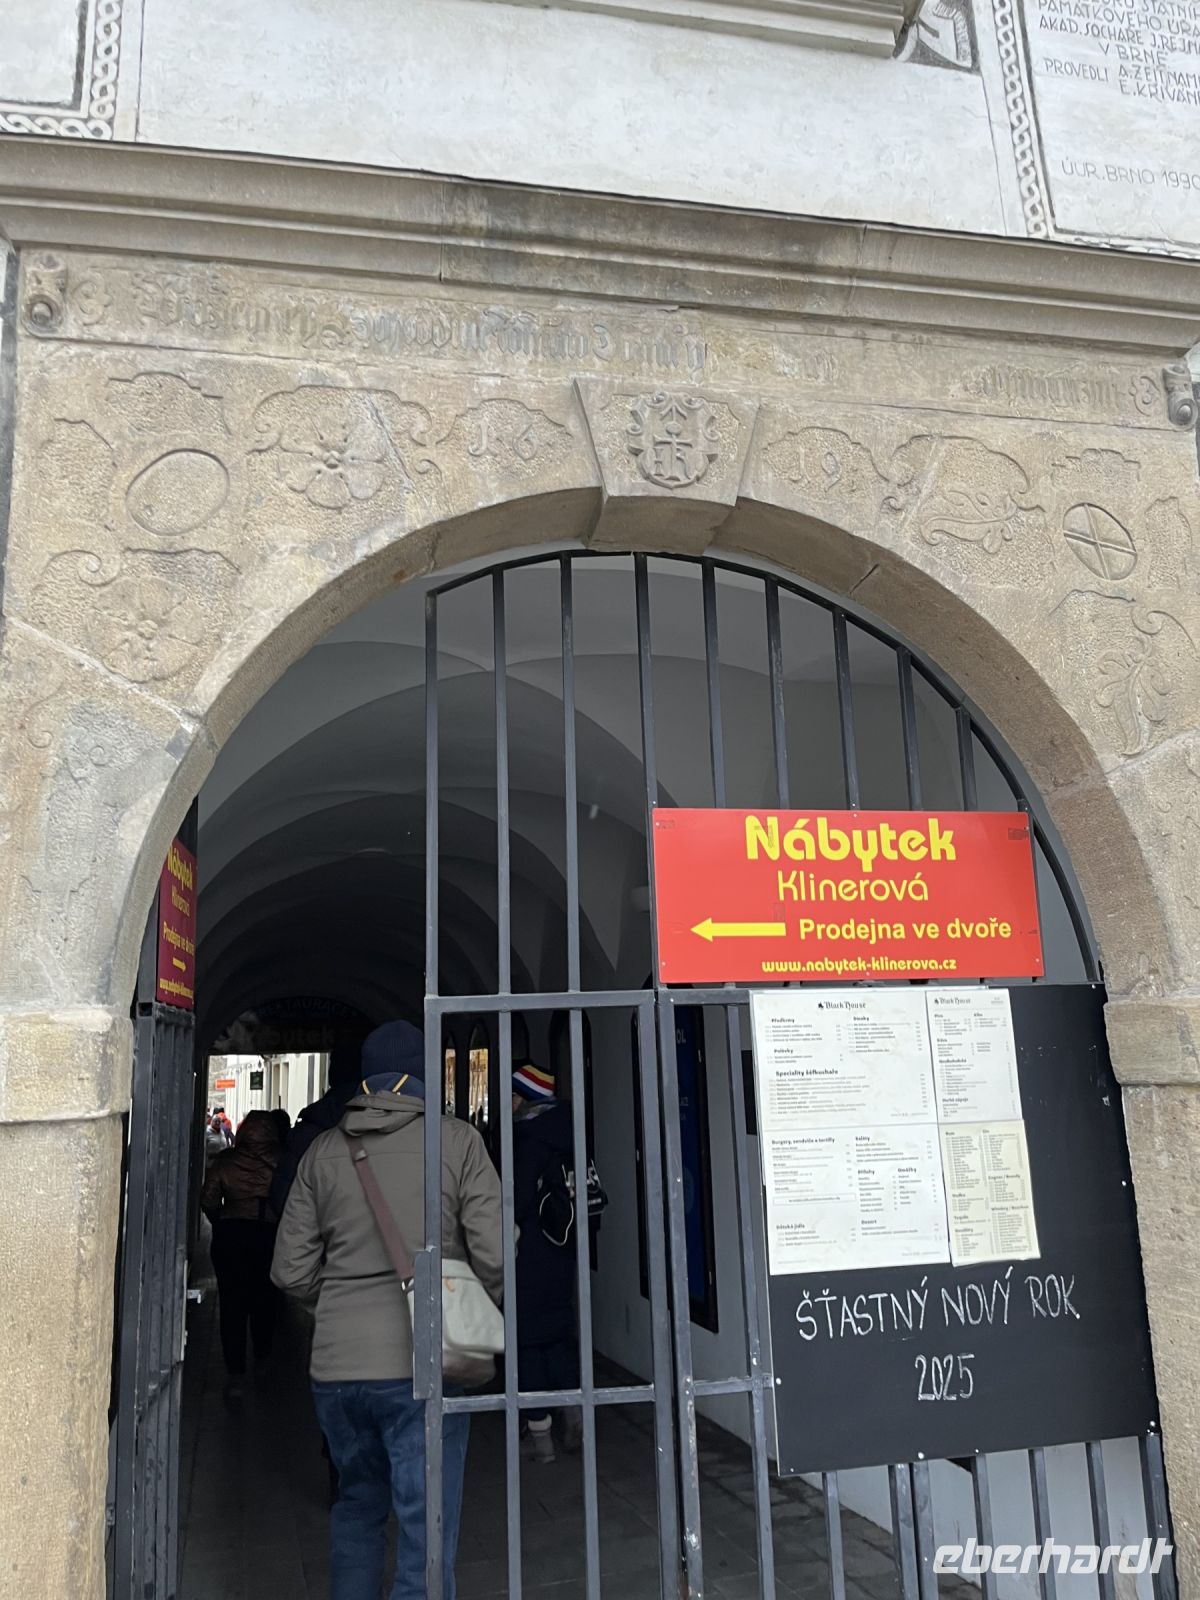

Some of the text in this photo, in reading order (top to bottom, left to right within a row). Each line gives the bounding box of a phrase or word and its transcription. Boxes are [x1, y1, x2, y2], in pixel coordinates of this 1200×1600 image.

[1099, 42, 1110, 55] V
[1043, 57, 1109, 82] PROVEDLI
[745, 815, 957, 872] Nábytek
[777, 870, 929, 901] Klinerová
[799, 917, 1012, 944] Prodejna ve dvoře
[761, 956, 958, 975] www.nabytek-klinerova.cz
[775, 1069, 804, 1077] Speciality
[795, 1265, 1077, 1341] ŠŤASTNÝ NOVÝ ROK
[914, 1352, 976, 1401] 2025
